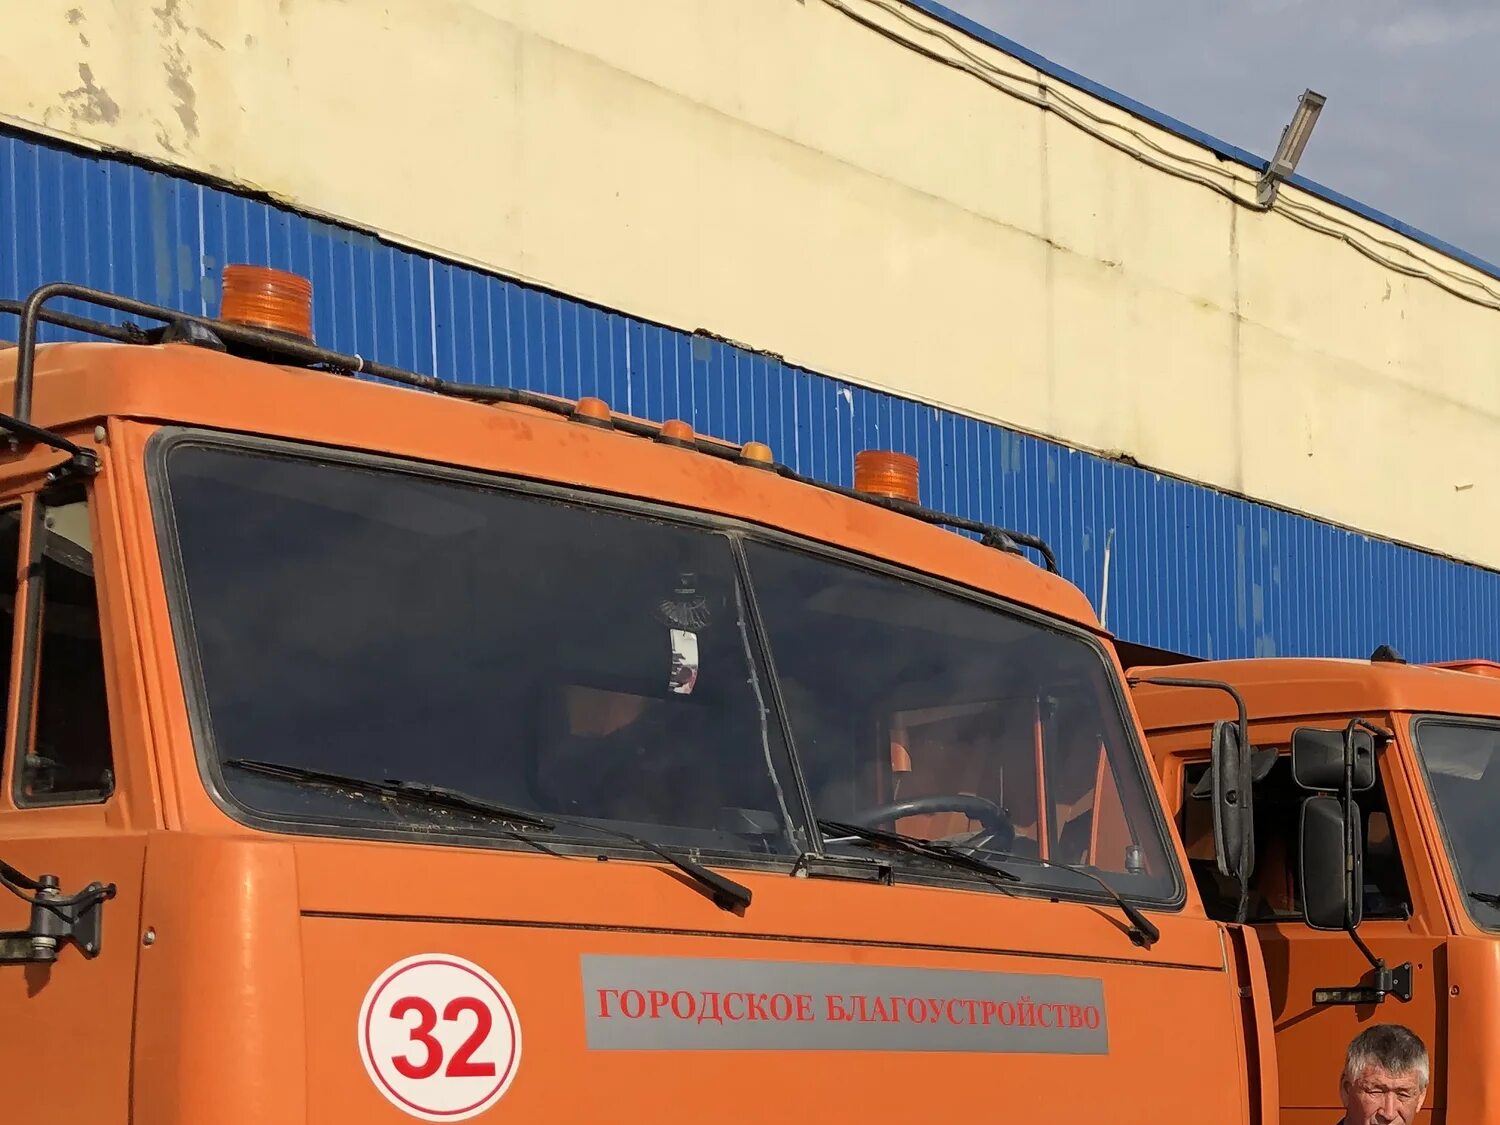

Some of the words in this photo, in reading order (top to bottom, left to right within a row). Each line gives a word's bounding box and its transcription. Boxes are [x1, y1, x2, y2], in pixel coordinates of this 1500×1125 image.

[389, 996, 497, 1080] 32
[596, 988, 815, 1025] ГОРОДСКОЕ
[825, 994, 1100, 1030] БЛАГОУСТРОЙСТВО
